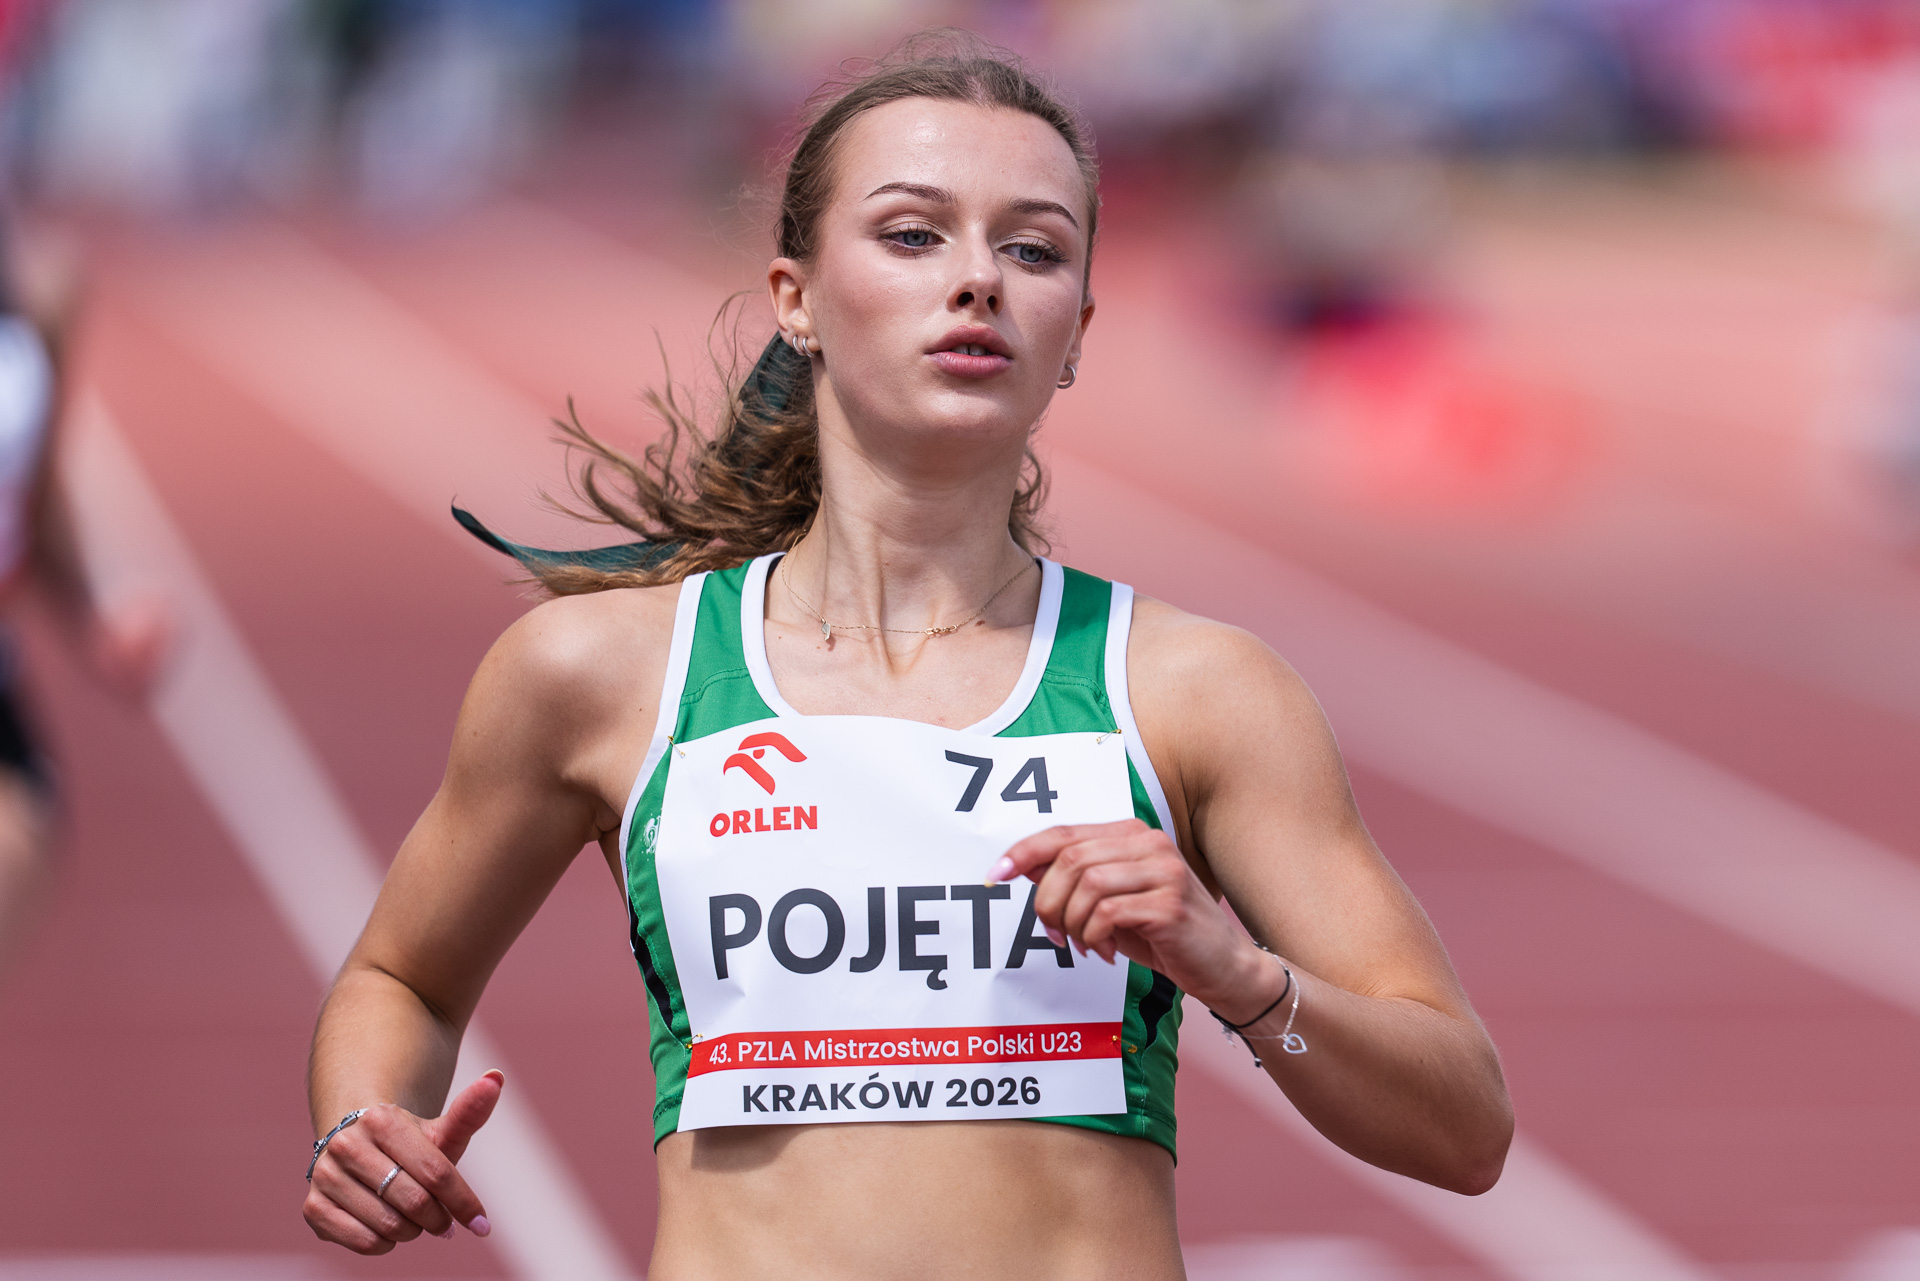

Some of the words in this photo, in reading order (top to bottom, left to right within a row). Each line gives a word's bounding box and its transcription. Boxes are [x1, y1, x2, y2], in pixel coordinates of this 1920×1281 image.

[944, 749, 1058, 814] 74
[709, 805, 818, 838] ORLEN
[708, 883, 1075, 991] POJĘTA
[708, 1043, 732, 1065] 43.
[738, 1039, 797, 1062] PZLA
[804, 1036, 960, 1061] Mistrzostwa
[967, 1032, 1034, 1056] Polski
[1040, 1031, 1082, 1054] U23
[742, 1071, 935, 1113] KRAKÓW
[945, 1076, 1042, 1107] 2026
